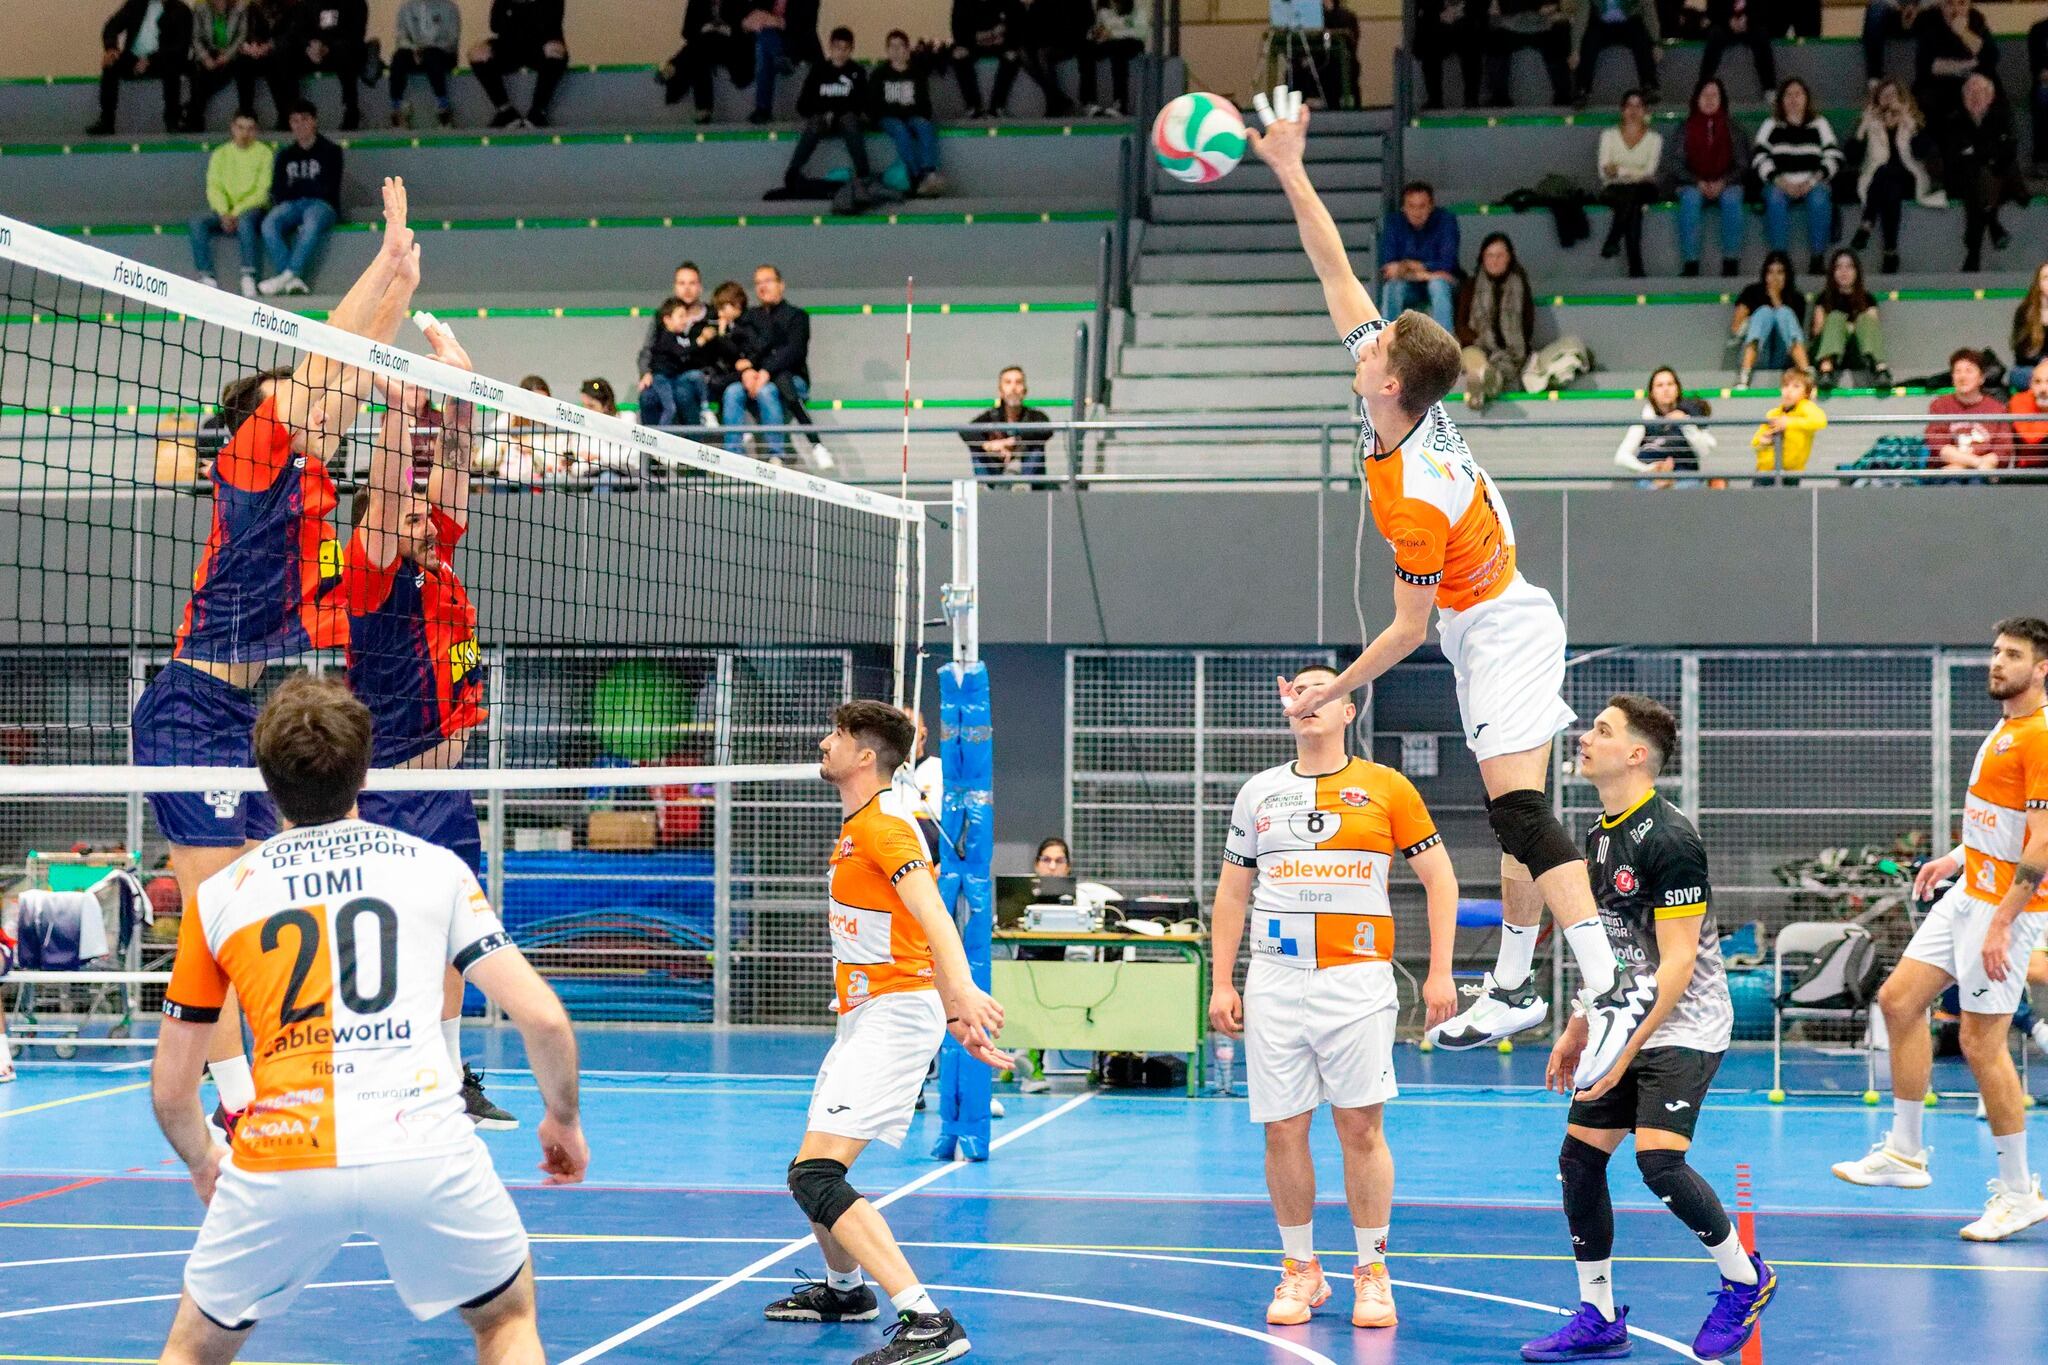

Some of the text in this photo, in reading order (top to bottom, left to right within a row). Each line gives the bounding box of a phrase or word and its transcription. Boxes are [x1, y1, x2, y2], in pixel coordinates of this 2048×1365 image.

[113, 261, 168, 297] rfevb.com
[251, 306, 299, 338] rfevb.com
[369, 345, 410, 373] rfevb.com
[469, 376, 504, 402] rfevb.com
[1307, 812, 1324, 833] 8
[262, 830, 401, 858] COMUNITAT
[272, 841, 419, 869] DE L'ESPORT
[1596, 834, 1610, 864] 10
[282, 866, 363, 901] TOMI
[1268, 859, 1373, 880] cableworld
[1299, 889, 1333, 902] fibra
[1664, 886, 1702, 906] SDVP
[260, 897, 398, 1030] 20
[264, 1018, 412, 1058] cableworld
[311, 1061, 355, 1076] fibra
